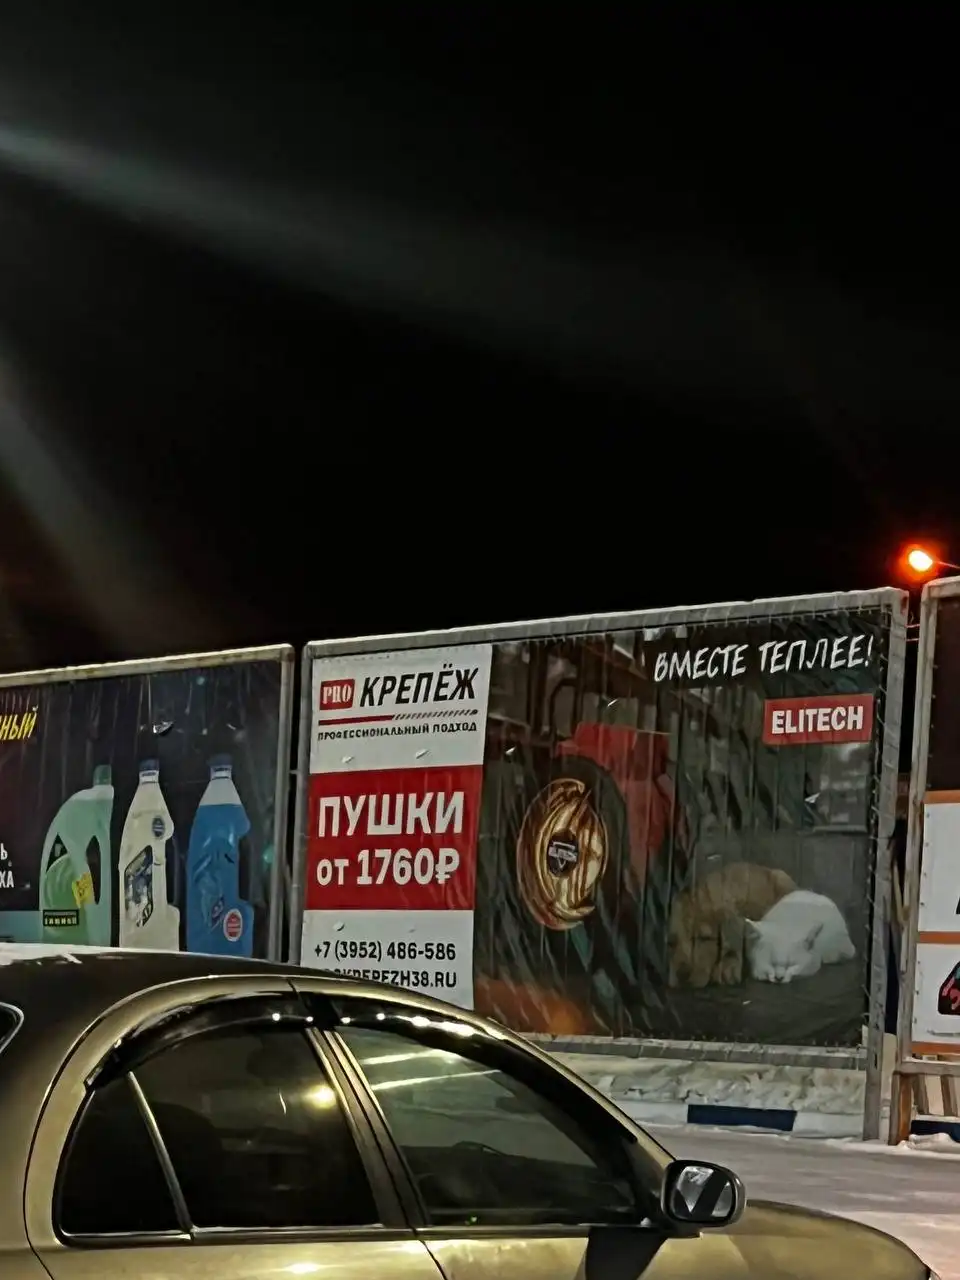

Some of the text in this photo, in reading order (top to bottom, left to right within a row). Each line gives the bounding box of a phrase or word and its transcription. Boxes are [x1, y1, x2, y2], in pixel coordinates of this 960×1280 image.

[654, 634, 874, 682] ВМЕСТЕ ТЕПЛЕЕ!
[359, 663, 479, 707] КРЕПЁЖ
[318, 721, 478, 741] ПРОФЕССИОНАЛЬНЫЙ ПОДХОД
[771, 706, 864, 734] ELITECH
[318, 791, 465, 837] ПУШКИ
[316, 847, 460, 886] от 1760₽
[314, 940, 456, 962] +7 (3952) 486-586
